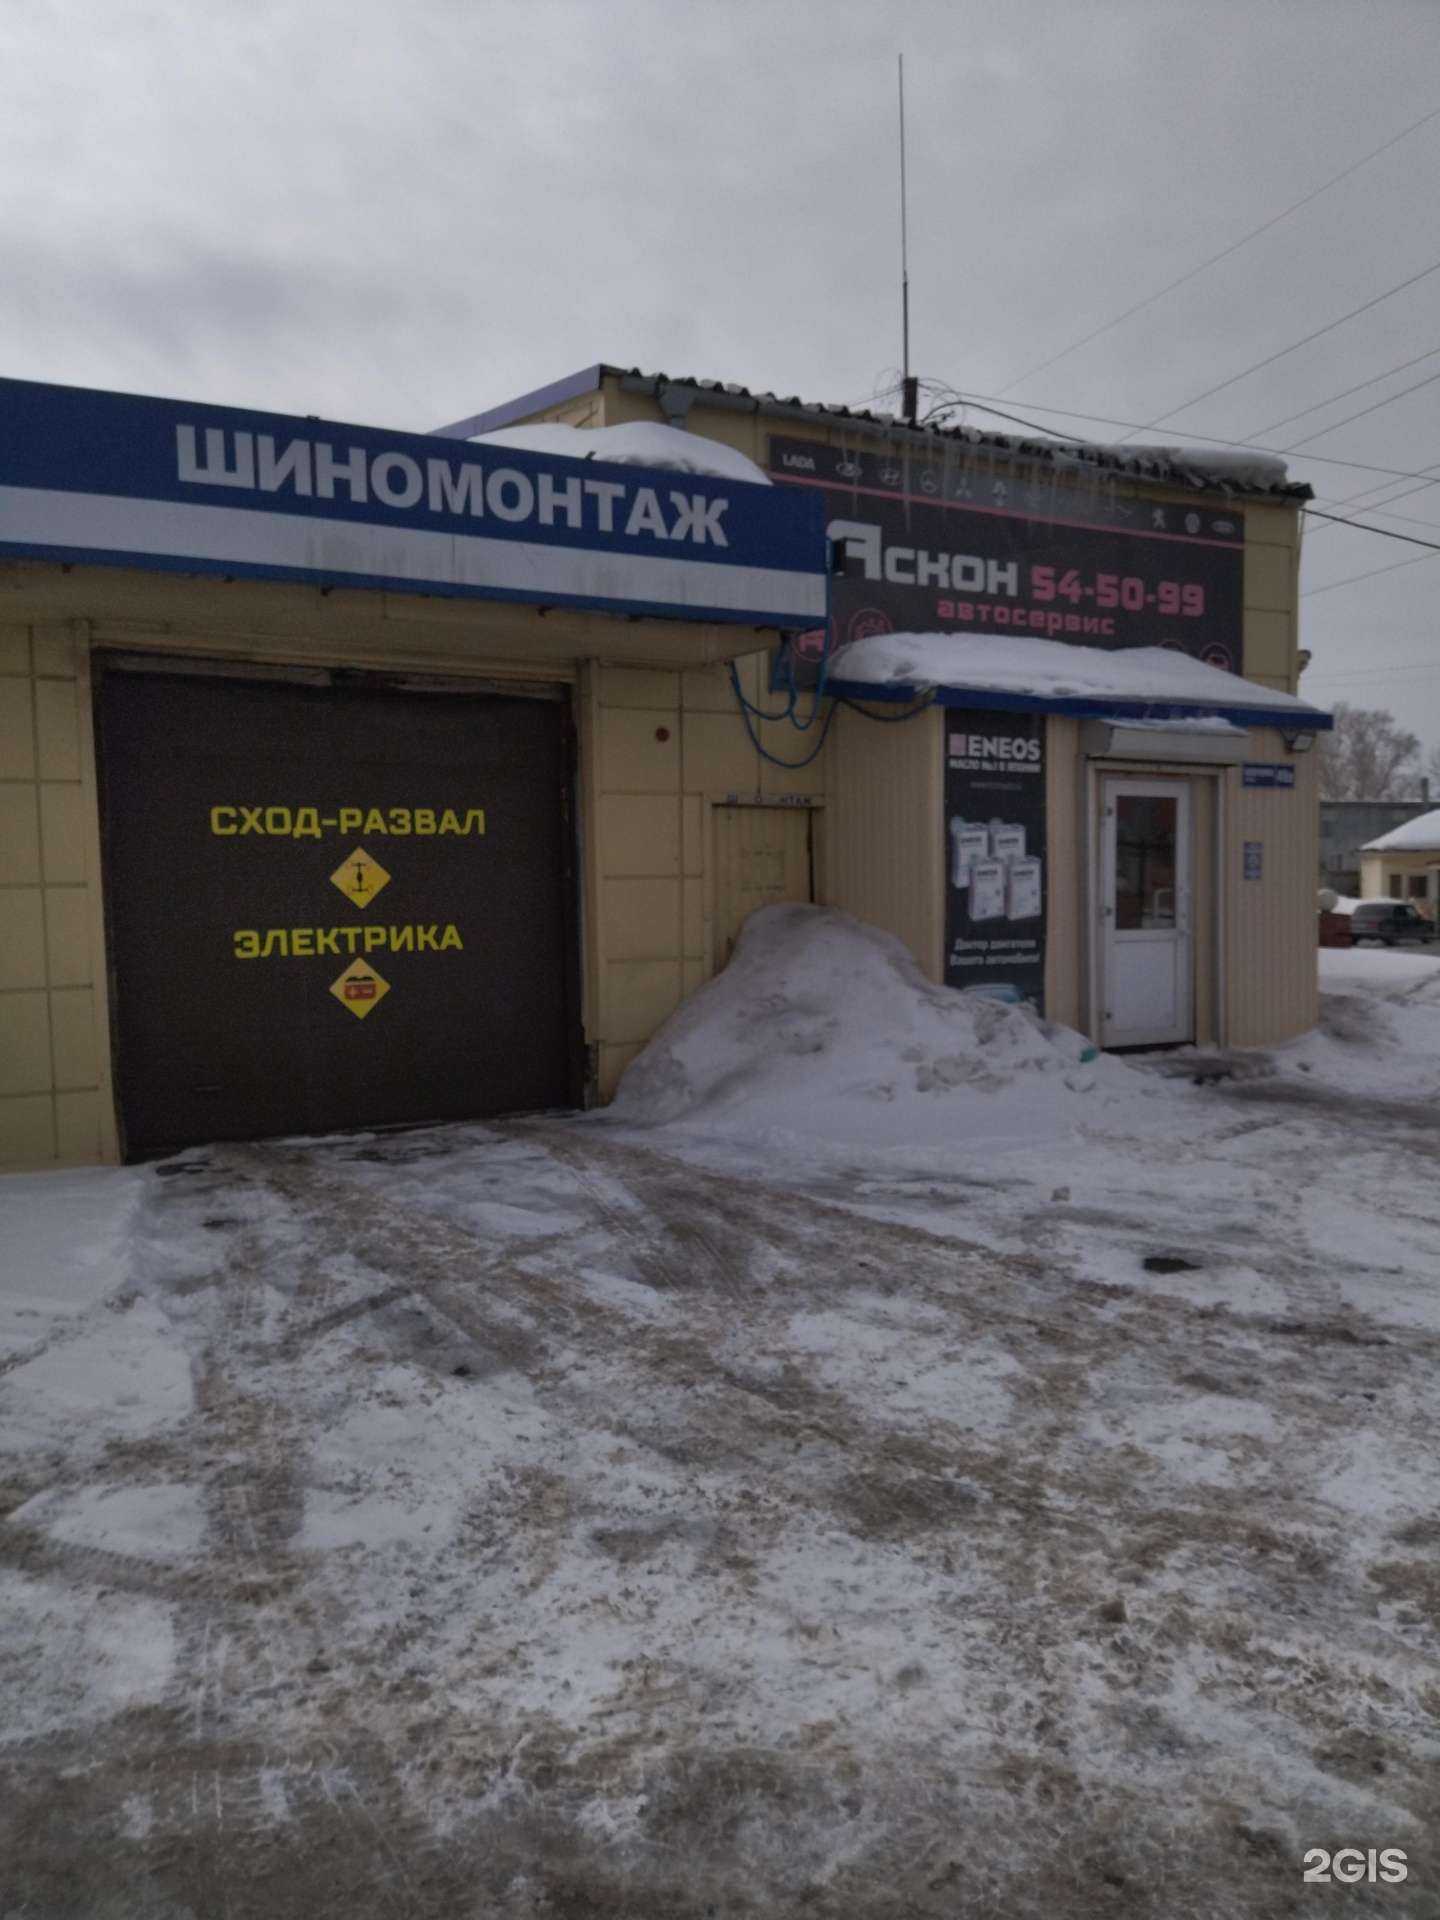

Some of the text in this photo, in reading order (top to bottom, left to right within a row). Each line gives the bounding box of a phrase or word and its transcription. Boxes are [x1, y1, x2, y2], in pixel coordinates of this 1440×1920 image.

[174, 423, 730, 548] ШИНОМОНТАЖ
[1031, 564, 1205, 617] 54-50-99
[937, 600, 1115, 636] автосервис
[967, 734, 1041, 761] ENEOS
[210, 806, 486, 839] СХОД-РАЗВАЛ
[232, 925, 464, 959] ЭЛЕКТРИКА
